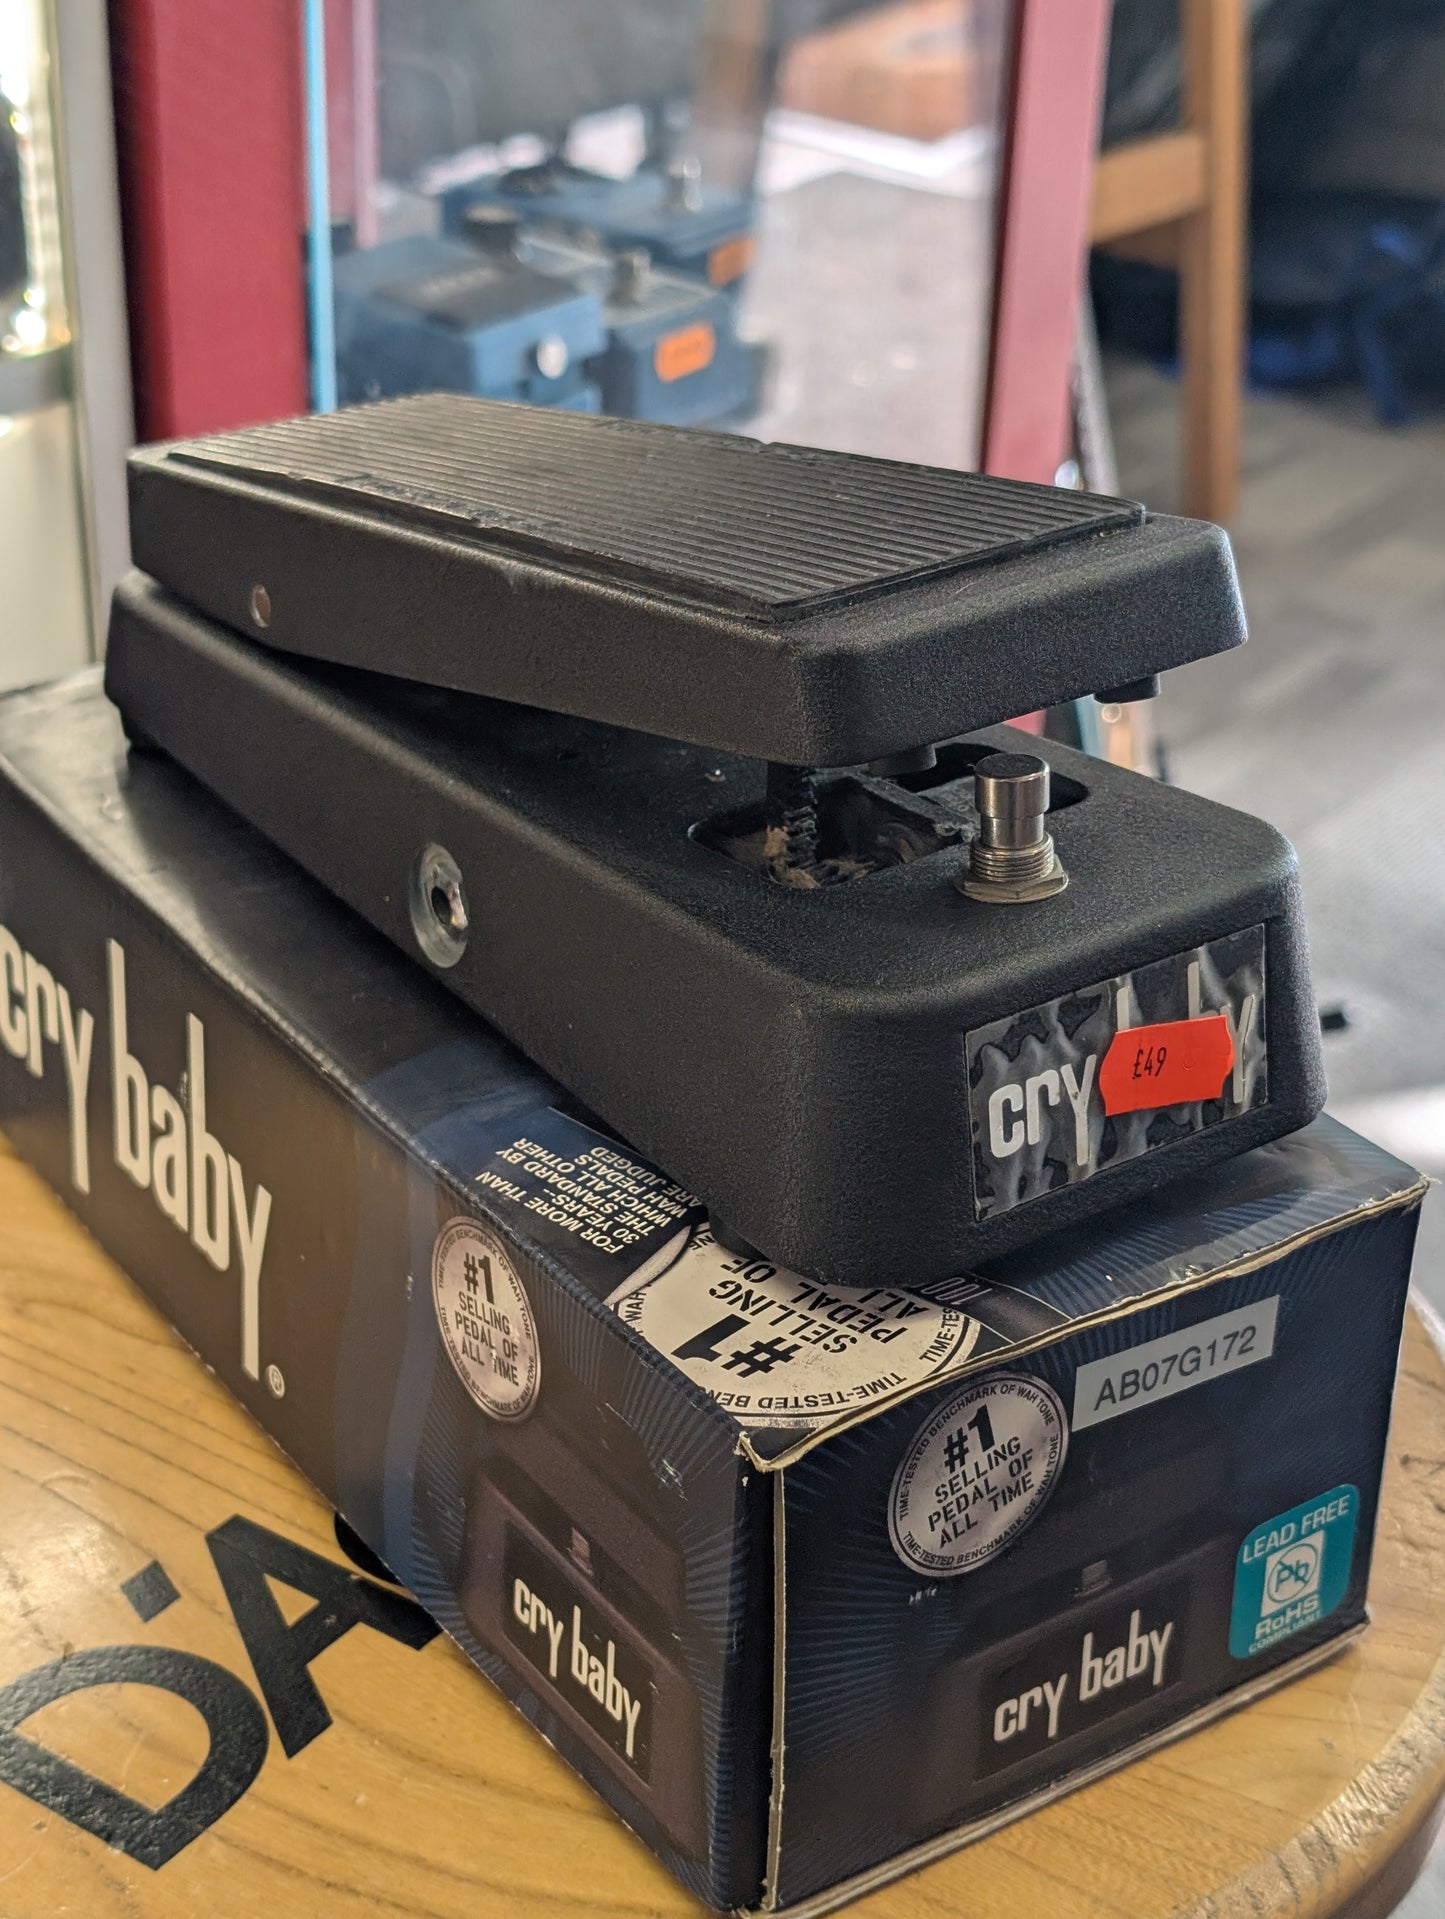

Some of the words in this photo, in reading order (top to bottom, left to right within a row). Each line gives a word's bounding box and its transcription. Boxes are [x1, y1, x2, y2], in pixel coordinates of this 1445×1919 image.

[0, 922, 94, 1194] cry
[1131, 1046, 1167, 1080] £49
[988, 1053, 1097, 1166] cry
[495, 1148, 526, 1164] BY
[512, 1137, 575, 1173] OTHER
[574, 1154, 645, 1194] PEDALS
[590, 1146, 667, 1186] JUDGED
[475, 1171, 527, 1202] THAN
[523, 1160, 619, 1215] STANDARD
[576, 1170, 612, 1191] ALL
[662, 1184, 703, 1208] ARE
[524, 1196, 584, 1232] MORE
[606, 1189, 672, 1227] WHICH
[614, 1210, 655, 1236] THE
[642, 1192, 688, 1219] WAH
[580, 1230, 624, 1254] FOR
[614, 1228, 640, 1244] 30
[463, 1252, 495, 1305] #1
[720, 1258, 777, 1285] OF
[454, 1309, 495, 1349] PEDAL
[502, 1337, 518, 1362] OF
[458, 1290, 511, 1335] SELLING
[519, 1306, 532, 1340] TONE
[709, 1279, 857, 1354] SELLING
[790, 1281, 908, 1344] PEDAL
[461, 1336, 485, 1366] ALL
[670, 1313, 803, 1379] #1
[1093, 1324, 1257, 1411] AB07G172
[757, 1372, 908, 1409] TIME-TESTED
[900, 1438, 930, 1521] TIME-TESTED
[929, 1384, 999, 1437] BENCHMARK
[1000, 1384, 1015, 1395] OF
[1017, 1386, 1038, 1403] WAH
[1035, 1398, 1056, 1427] TONE
[942, 1404, 995, 1474] #1
[928, 1477, 998, 1532] PEDAL
[1008, 1448, 1034, 1477] OF
[934, 1436, 1022, 1504] SELLING
[939, 1513, 978, 1549] ALL
[988, 1471, 1034, 1513] TIME
[1242, 1521, 1297, 1563] LEAD
[1301, 1494, 1351, 1535] FREE
[903, 1531, 954, 1566] TIME-TESTED
[956, 1517, 1024, 1563] BENCHMARK
[1255, 1593, 1319, 1640] RoHS
[514, 1578, 564, 1678] cry
[571, 1605, 641, 1758] baby
[993, 1673, 1069, 1742] cry
[1079, 1608, 1173, 1702] baby
